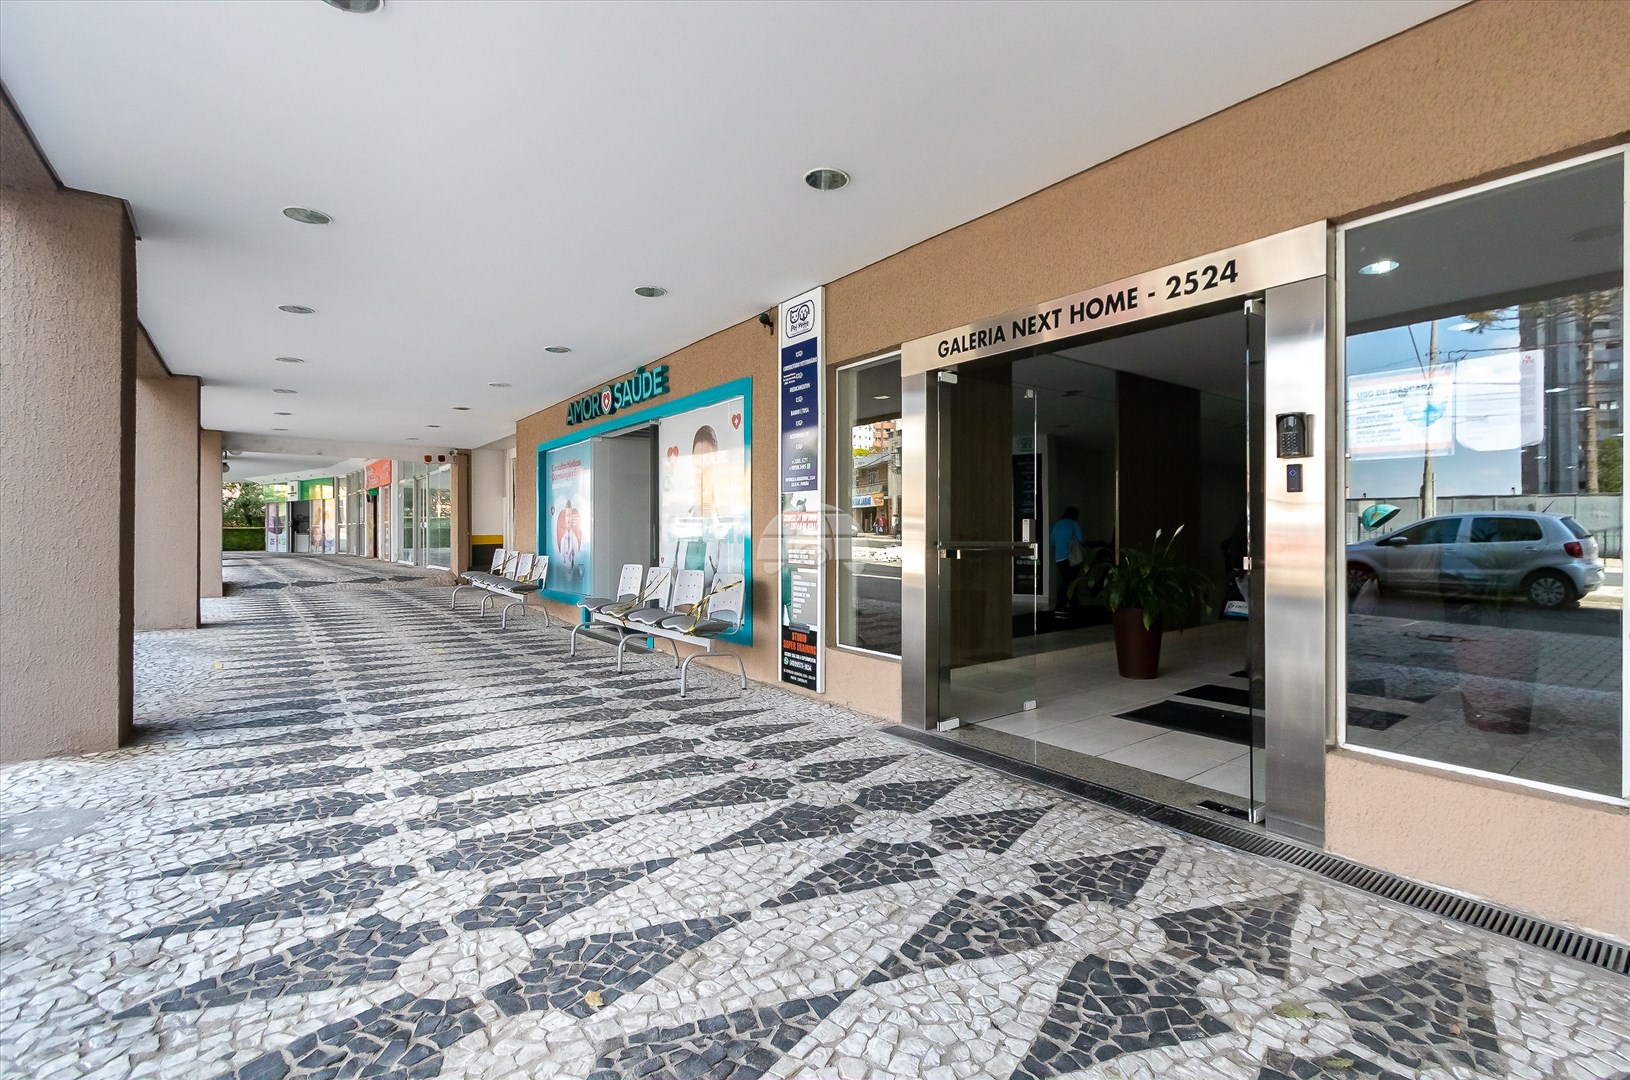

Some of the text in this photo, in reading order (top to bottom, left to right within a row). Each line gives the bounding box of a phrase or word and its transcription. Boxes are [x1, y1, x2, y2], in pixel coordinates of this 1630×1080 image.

[938, 326, 1006, 358] GALERIA
[1012, 308, 1062, 340] NEXT
[1070, 287, 1138, 325] HOME
[1166, 259, 1238, 300] 2524
[566, 365, 669, 425] AMOR SAÚDE
[796, 642, 817, 656] TRAINING
